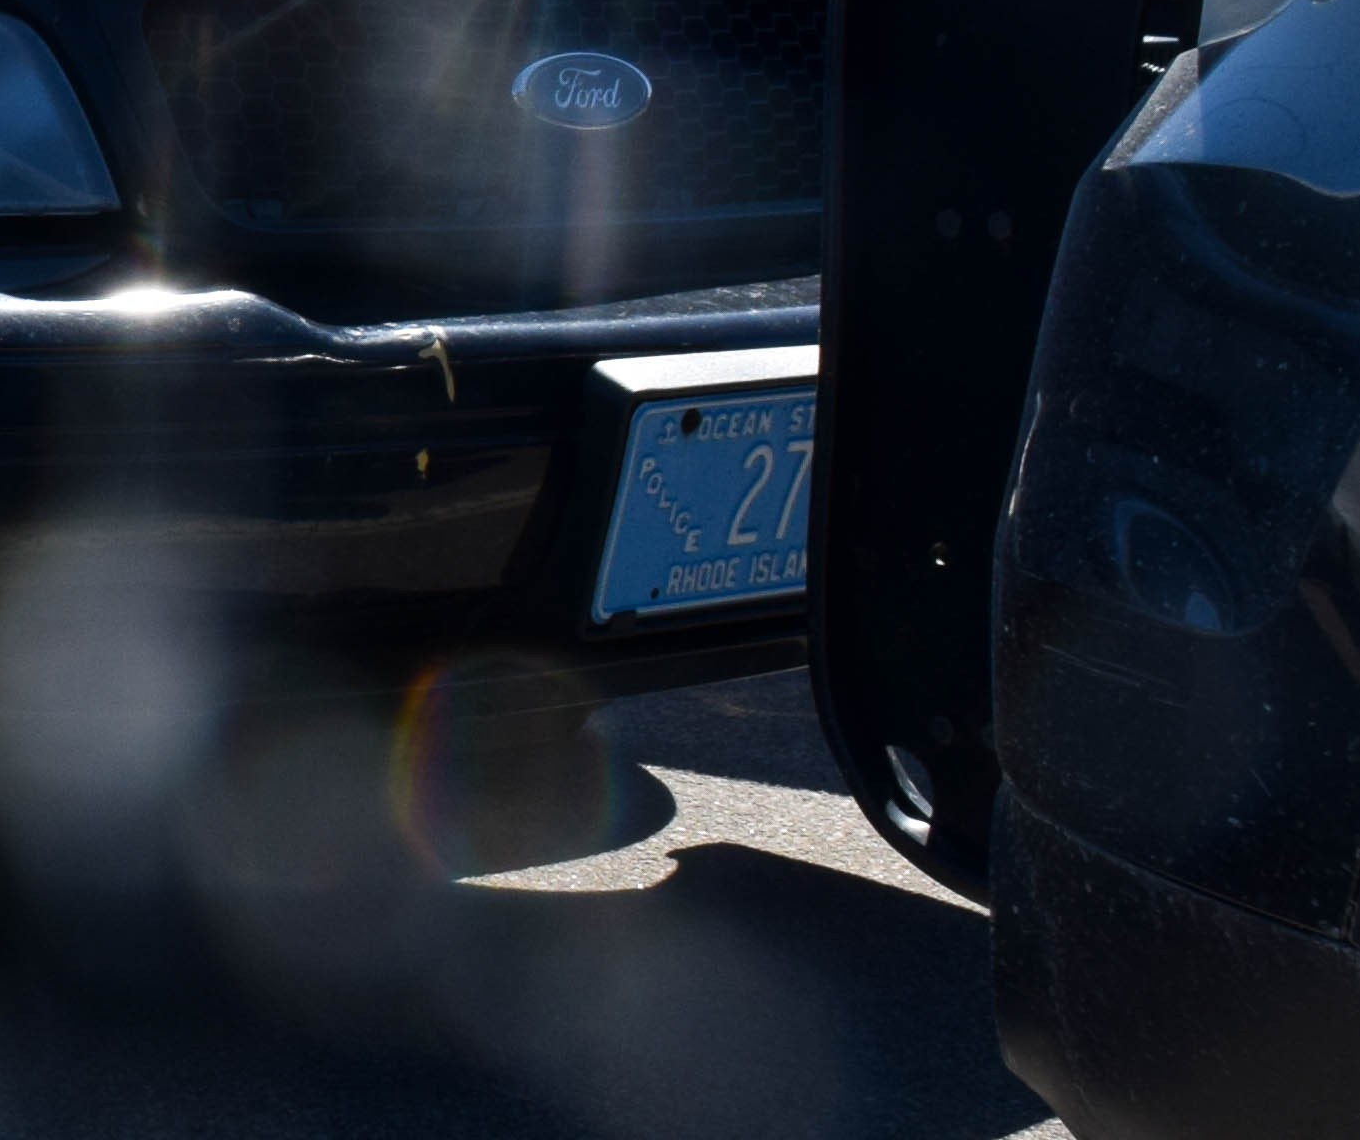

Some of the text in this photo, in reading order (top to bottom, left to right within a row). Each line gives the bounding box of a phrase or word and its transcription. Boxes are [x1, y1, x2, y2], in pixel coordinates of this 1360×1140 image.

[554, 67, 622, 109] Ford
[696, 405, 816, 441] OCEAN ST
[639, 456, 703, 552] POLICE
[726, 439, 815, 545] 27
[665, 556, 741, 596] RHODE
